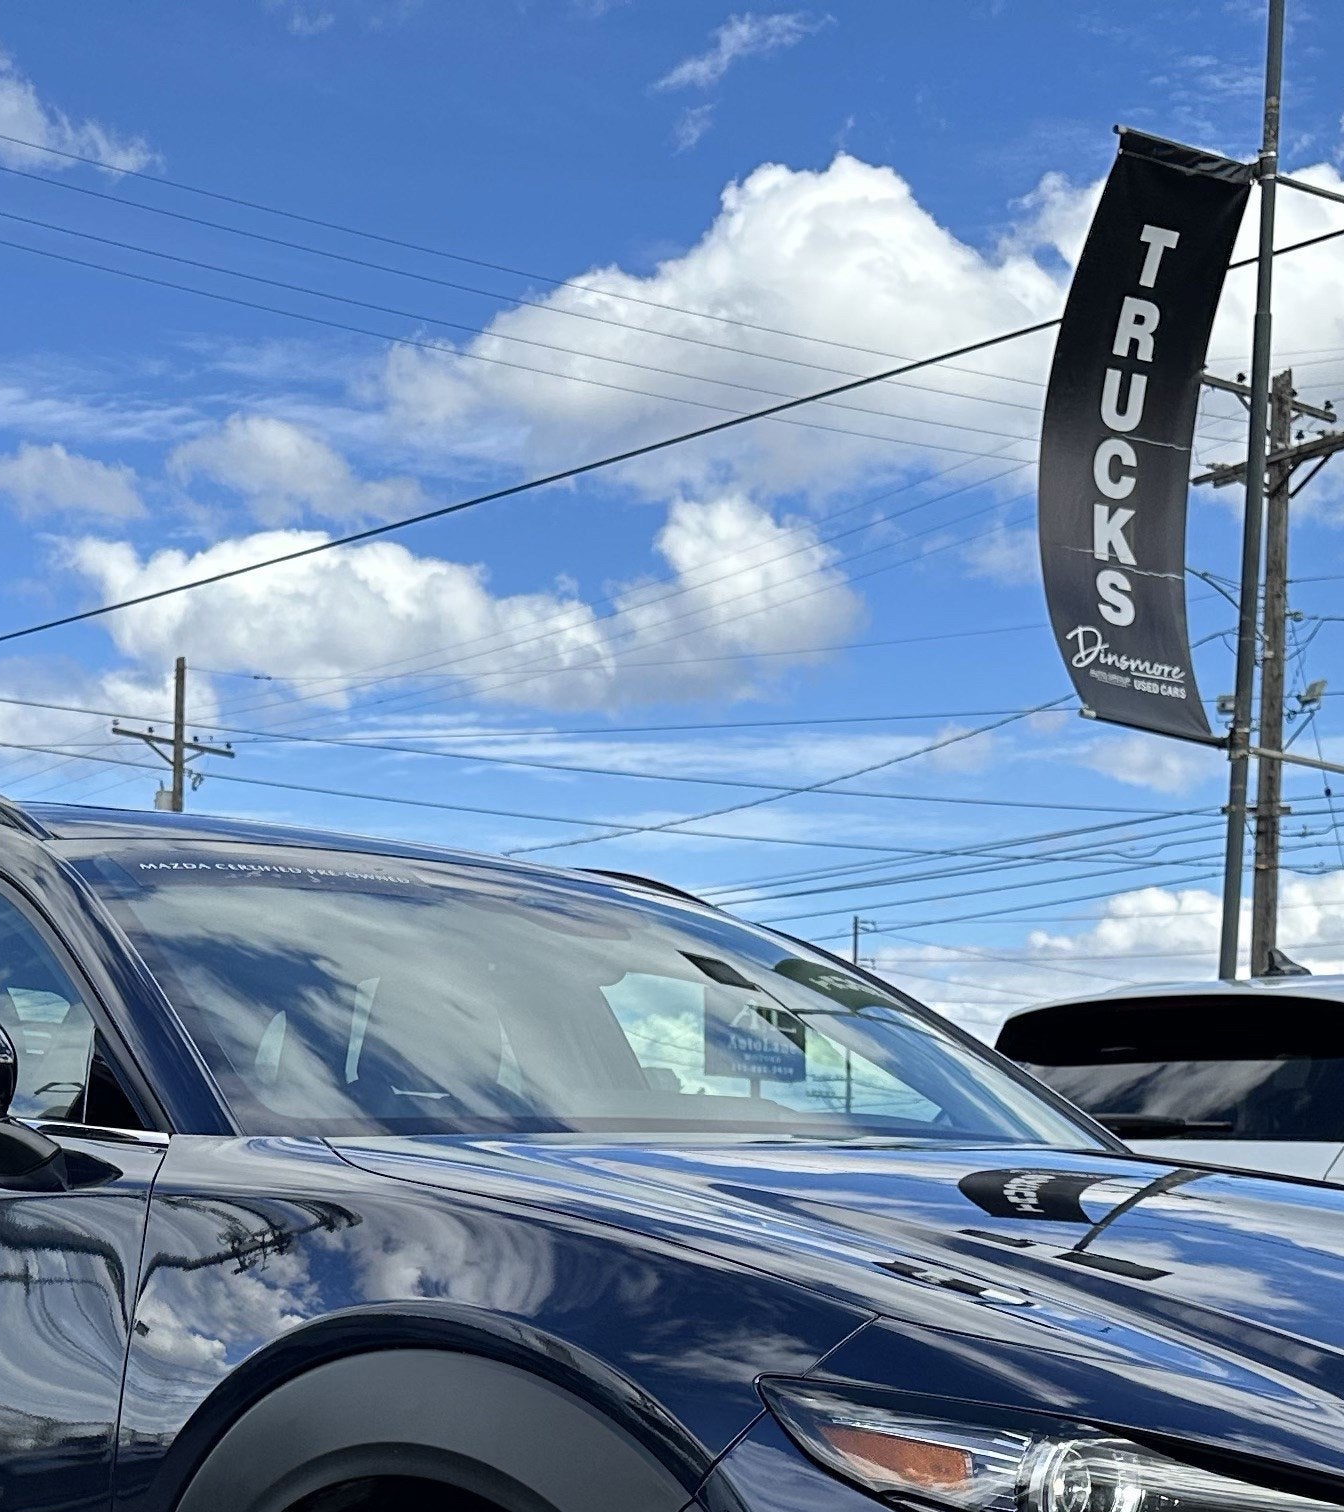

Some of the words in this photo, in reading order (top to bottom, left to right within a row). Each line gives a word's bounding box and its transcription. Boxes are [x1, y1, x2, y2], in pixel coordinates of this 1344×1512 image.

[1093, 224, 1180, 627] TRUCKS
[1066, 626, 1186, 682] Dinsmore
[1134, 679, 1159, 694] USED
[1160, 683, 1187, 699] CARS
[139, 862, 211, 870] MAZDA
[215, 863, 302, 874] CERTIFIED
